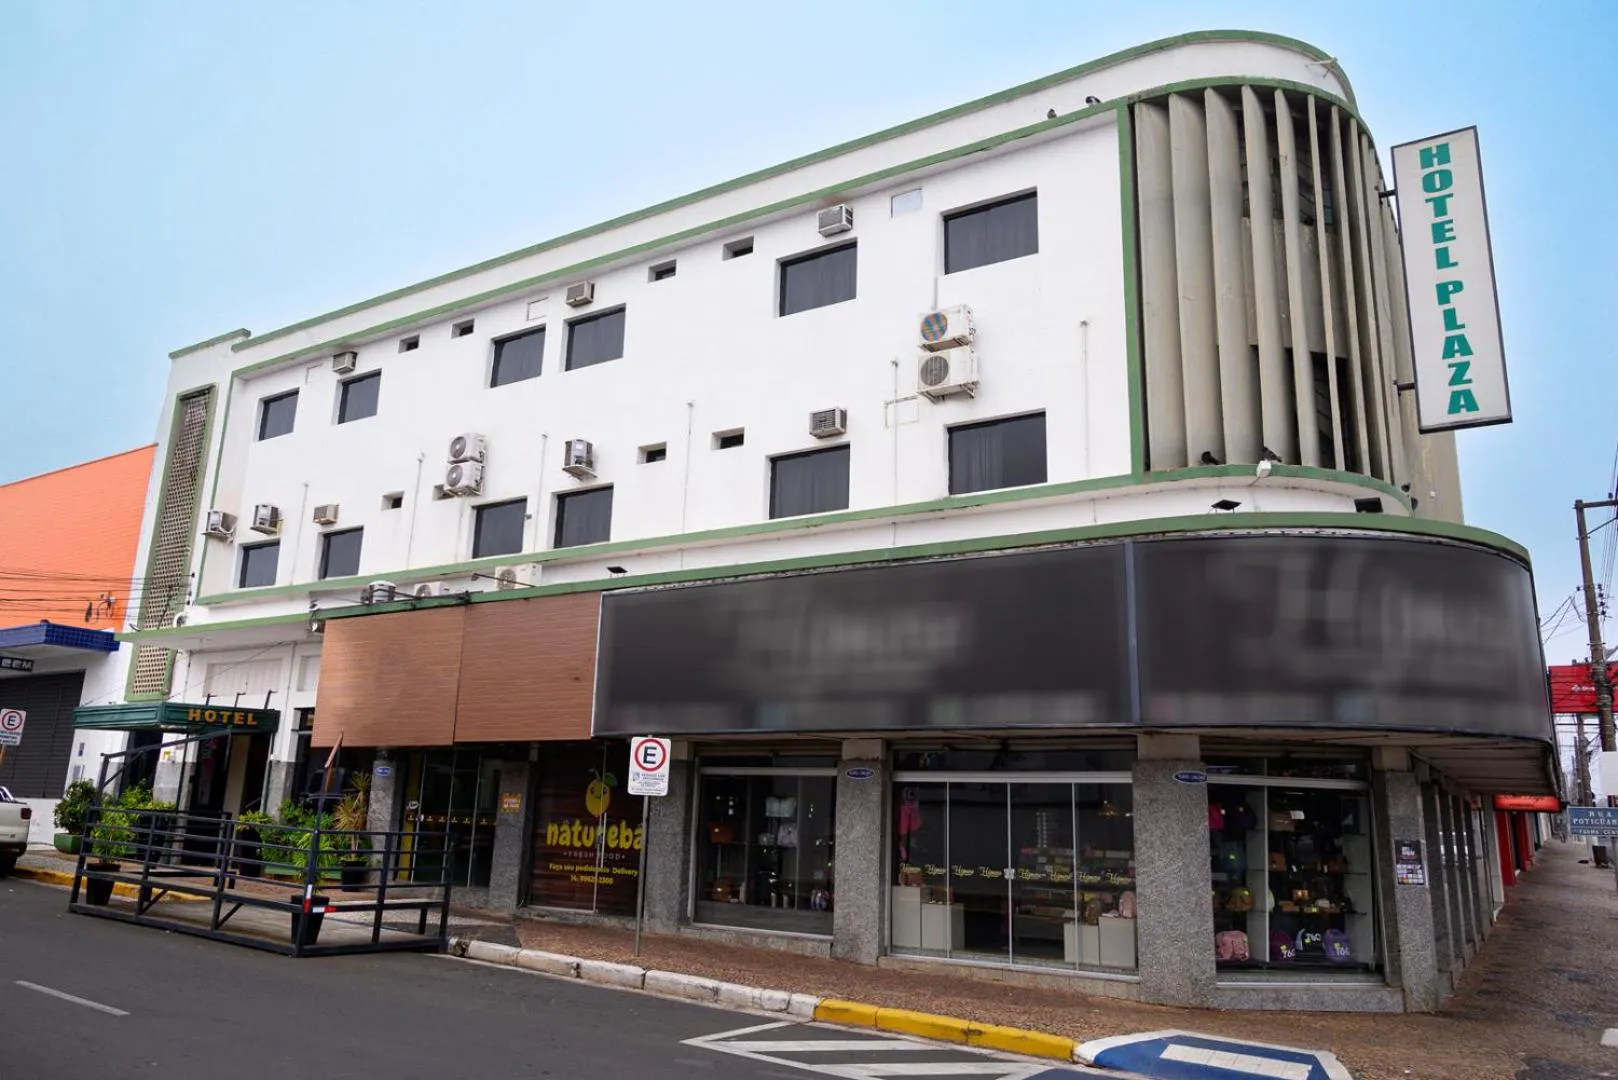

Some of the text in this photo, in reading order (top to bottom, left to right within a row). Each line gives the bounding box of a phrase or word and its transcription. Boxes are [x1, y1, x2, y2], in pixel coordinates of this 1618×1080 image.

[1418, 142, 1480, 415] HOTEL PLAZA
[7, 715, 16, 726] E
[187, 708, 257, 725] HOTEL
[643, 746, 657, 764] E
